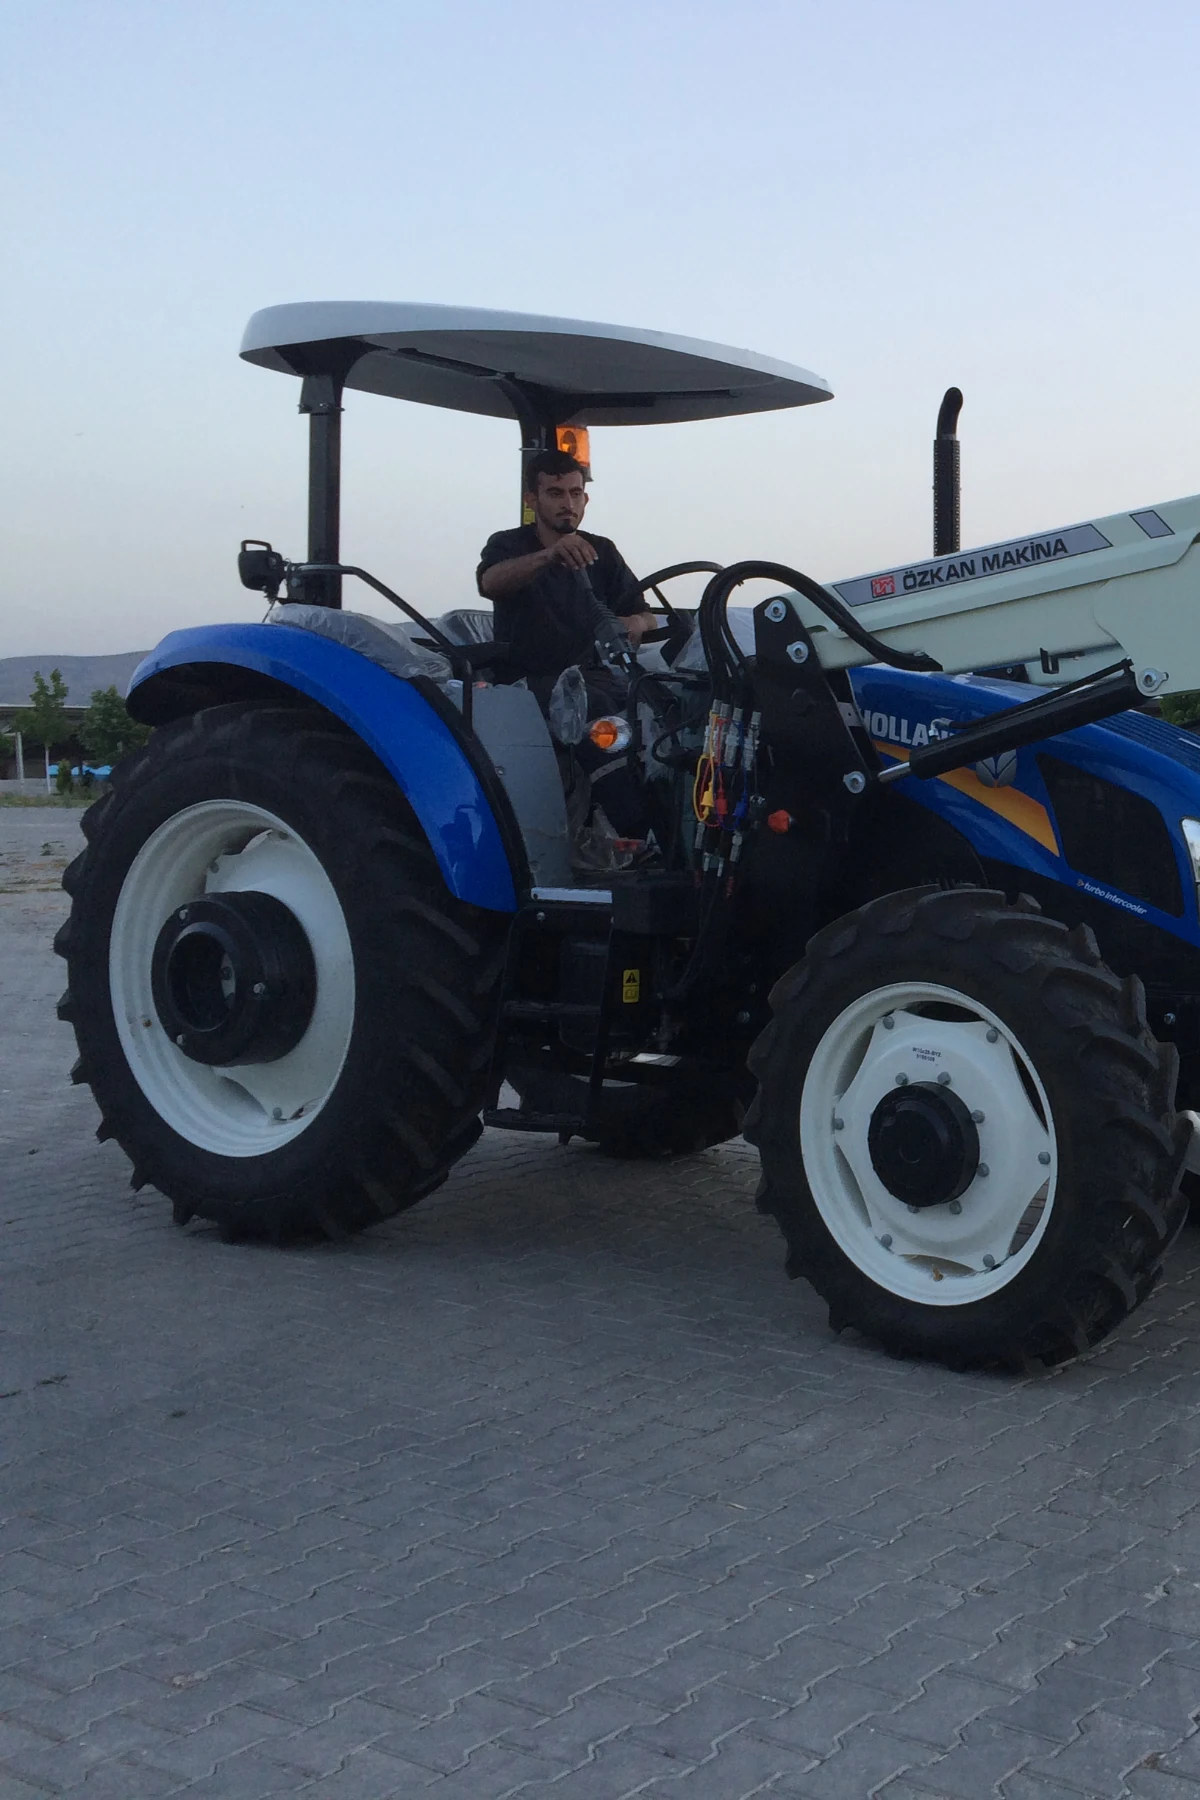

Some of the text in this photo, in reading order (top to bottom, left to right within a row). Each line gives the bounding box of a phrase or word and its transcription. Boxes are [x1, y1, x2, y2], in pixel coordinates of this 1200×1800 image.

[903, 560, 976, 591] ÖZKAN
[982, 538, 1068, 573] MAKİNA
[1084, 882, 1147, 914] turbo intercooler
